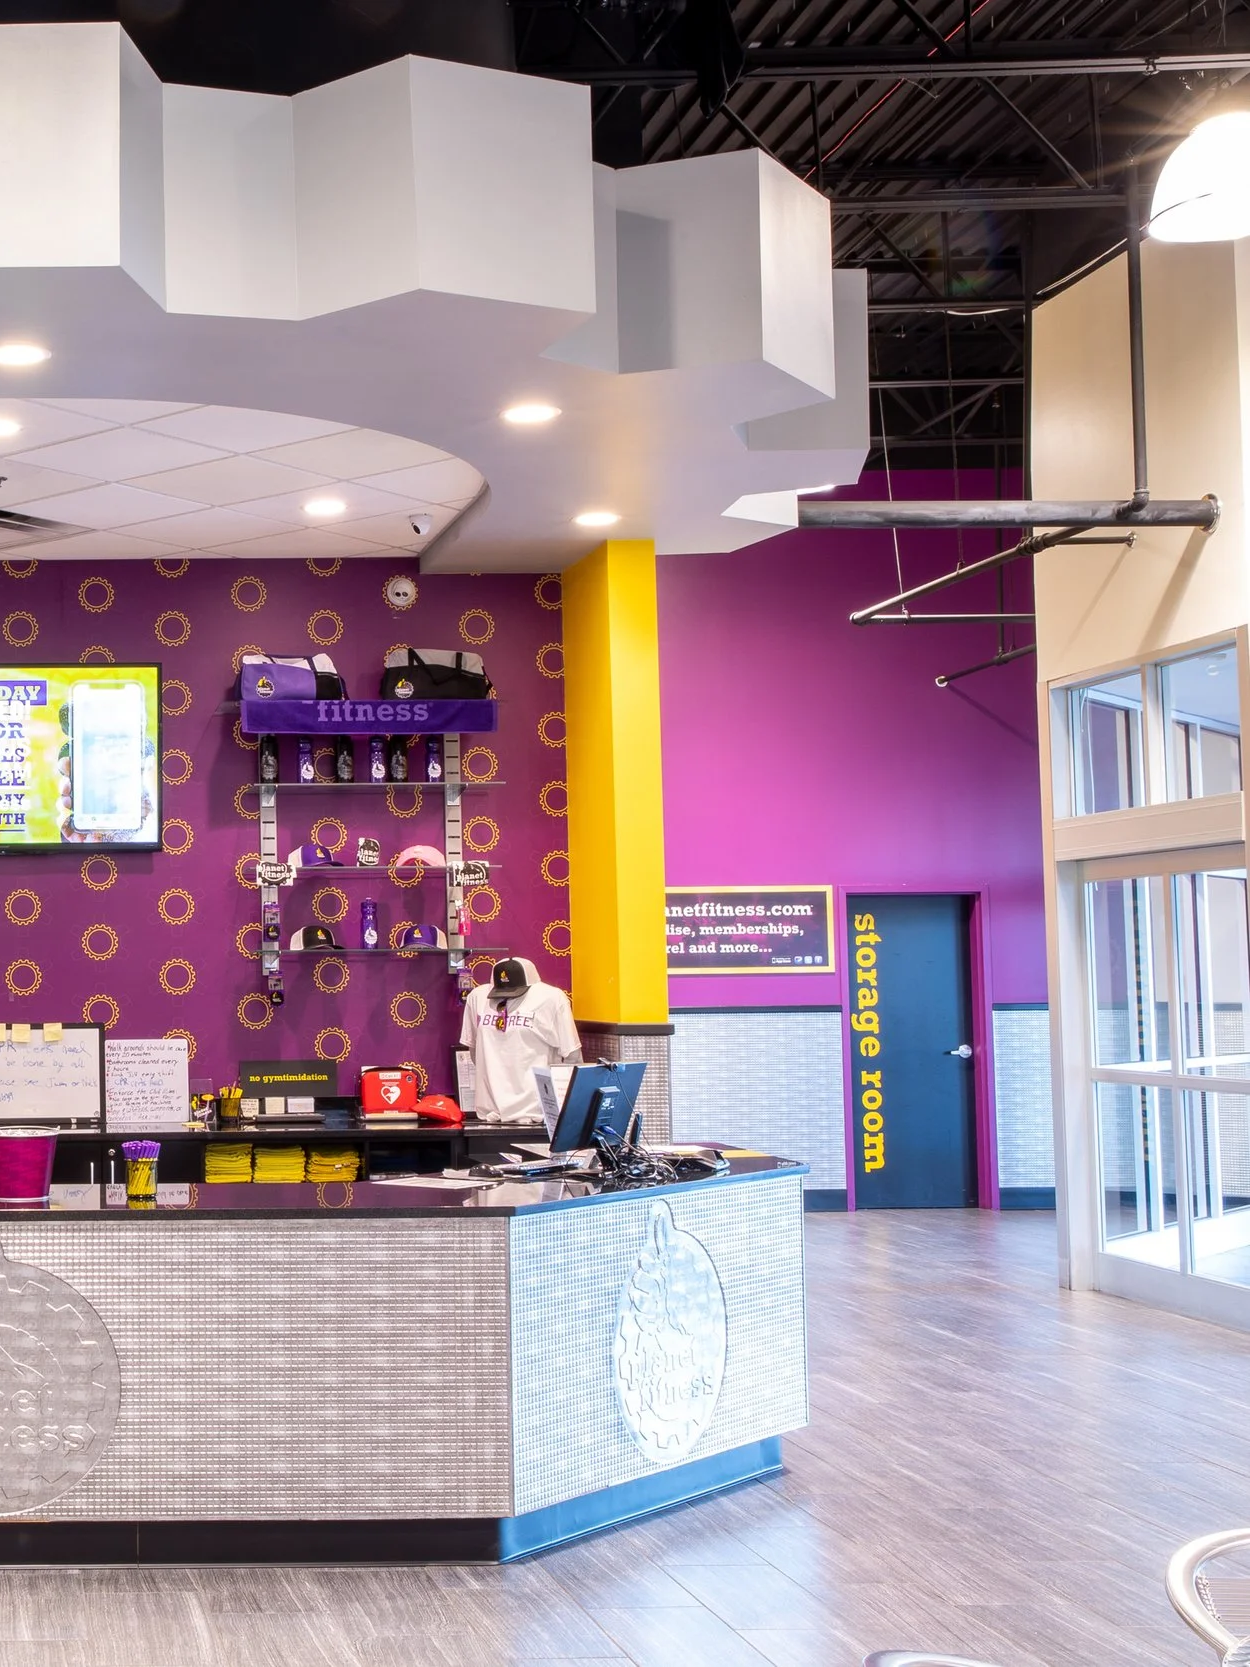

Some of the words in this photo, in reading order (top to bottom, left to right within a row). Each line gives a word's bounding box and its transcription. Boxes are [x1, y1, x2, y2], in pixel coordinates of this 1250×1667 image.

[317, 701, 429, 722] fitness
[699, 923, 804, 938] memberships,
[688, 941, 717, 954] and
[720, 942, 773, 954] more...
[851, 913, 881, 1057] storage
[249, 1074, 260, 1082] no
[262, 1073, 329, 1084] gymtimidation
[861, 1069, 886, 1173] room
